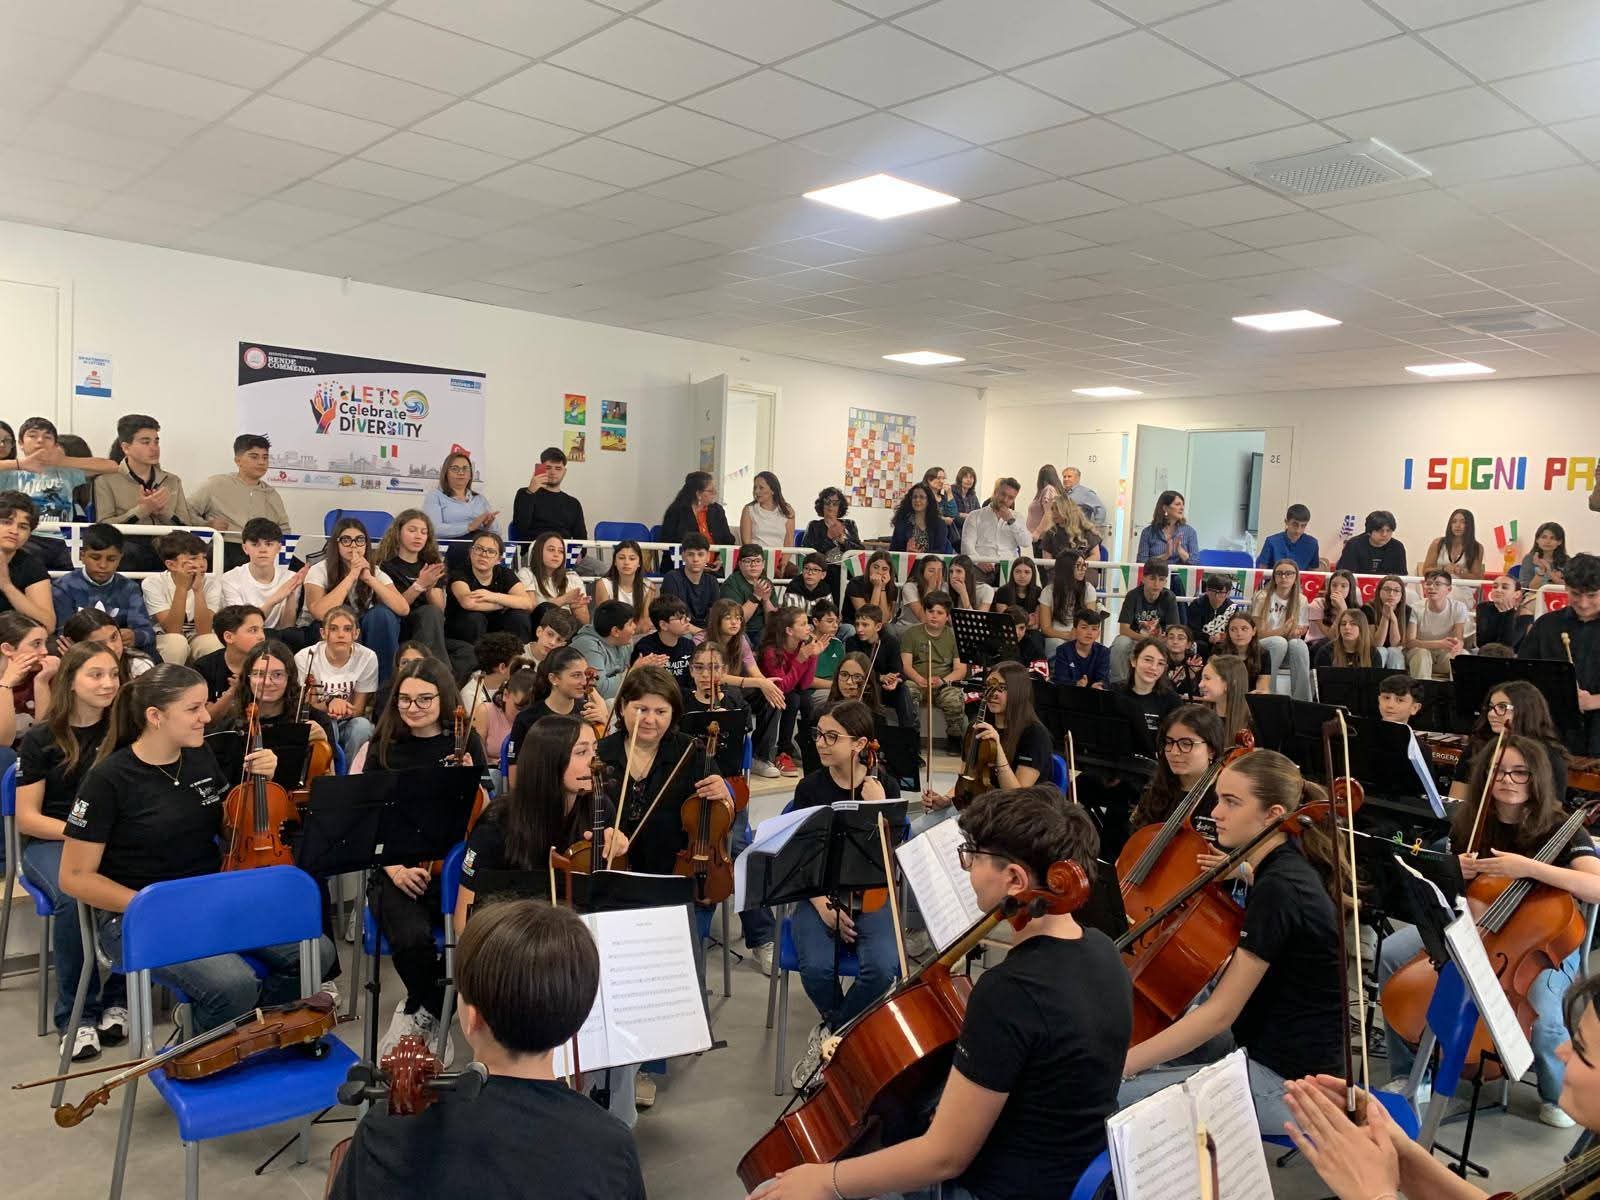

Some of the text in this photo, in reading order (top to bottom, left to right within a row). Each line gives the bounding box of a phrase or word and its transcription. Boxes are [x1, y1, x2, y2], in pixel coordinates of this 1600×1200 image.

[267, 356, 296, 365] RENDE
[267, 363, 315, 373] COMMENDA
[350, 384, 400, 406] LET'S
[339, 402, 407, 420] Celebrate
[1404, 456, 1600, 491] I SOGNI PA
[1431, 751, 1459, 761] ERGERA
